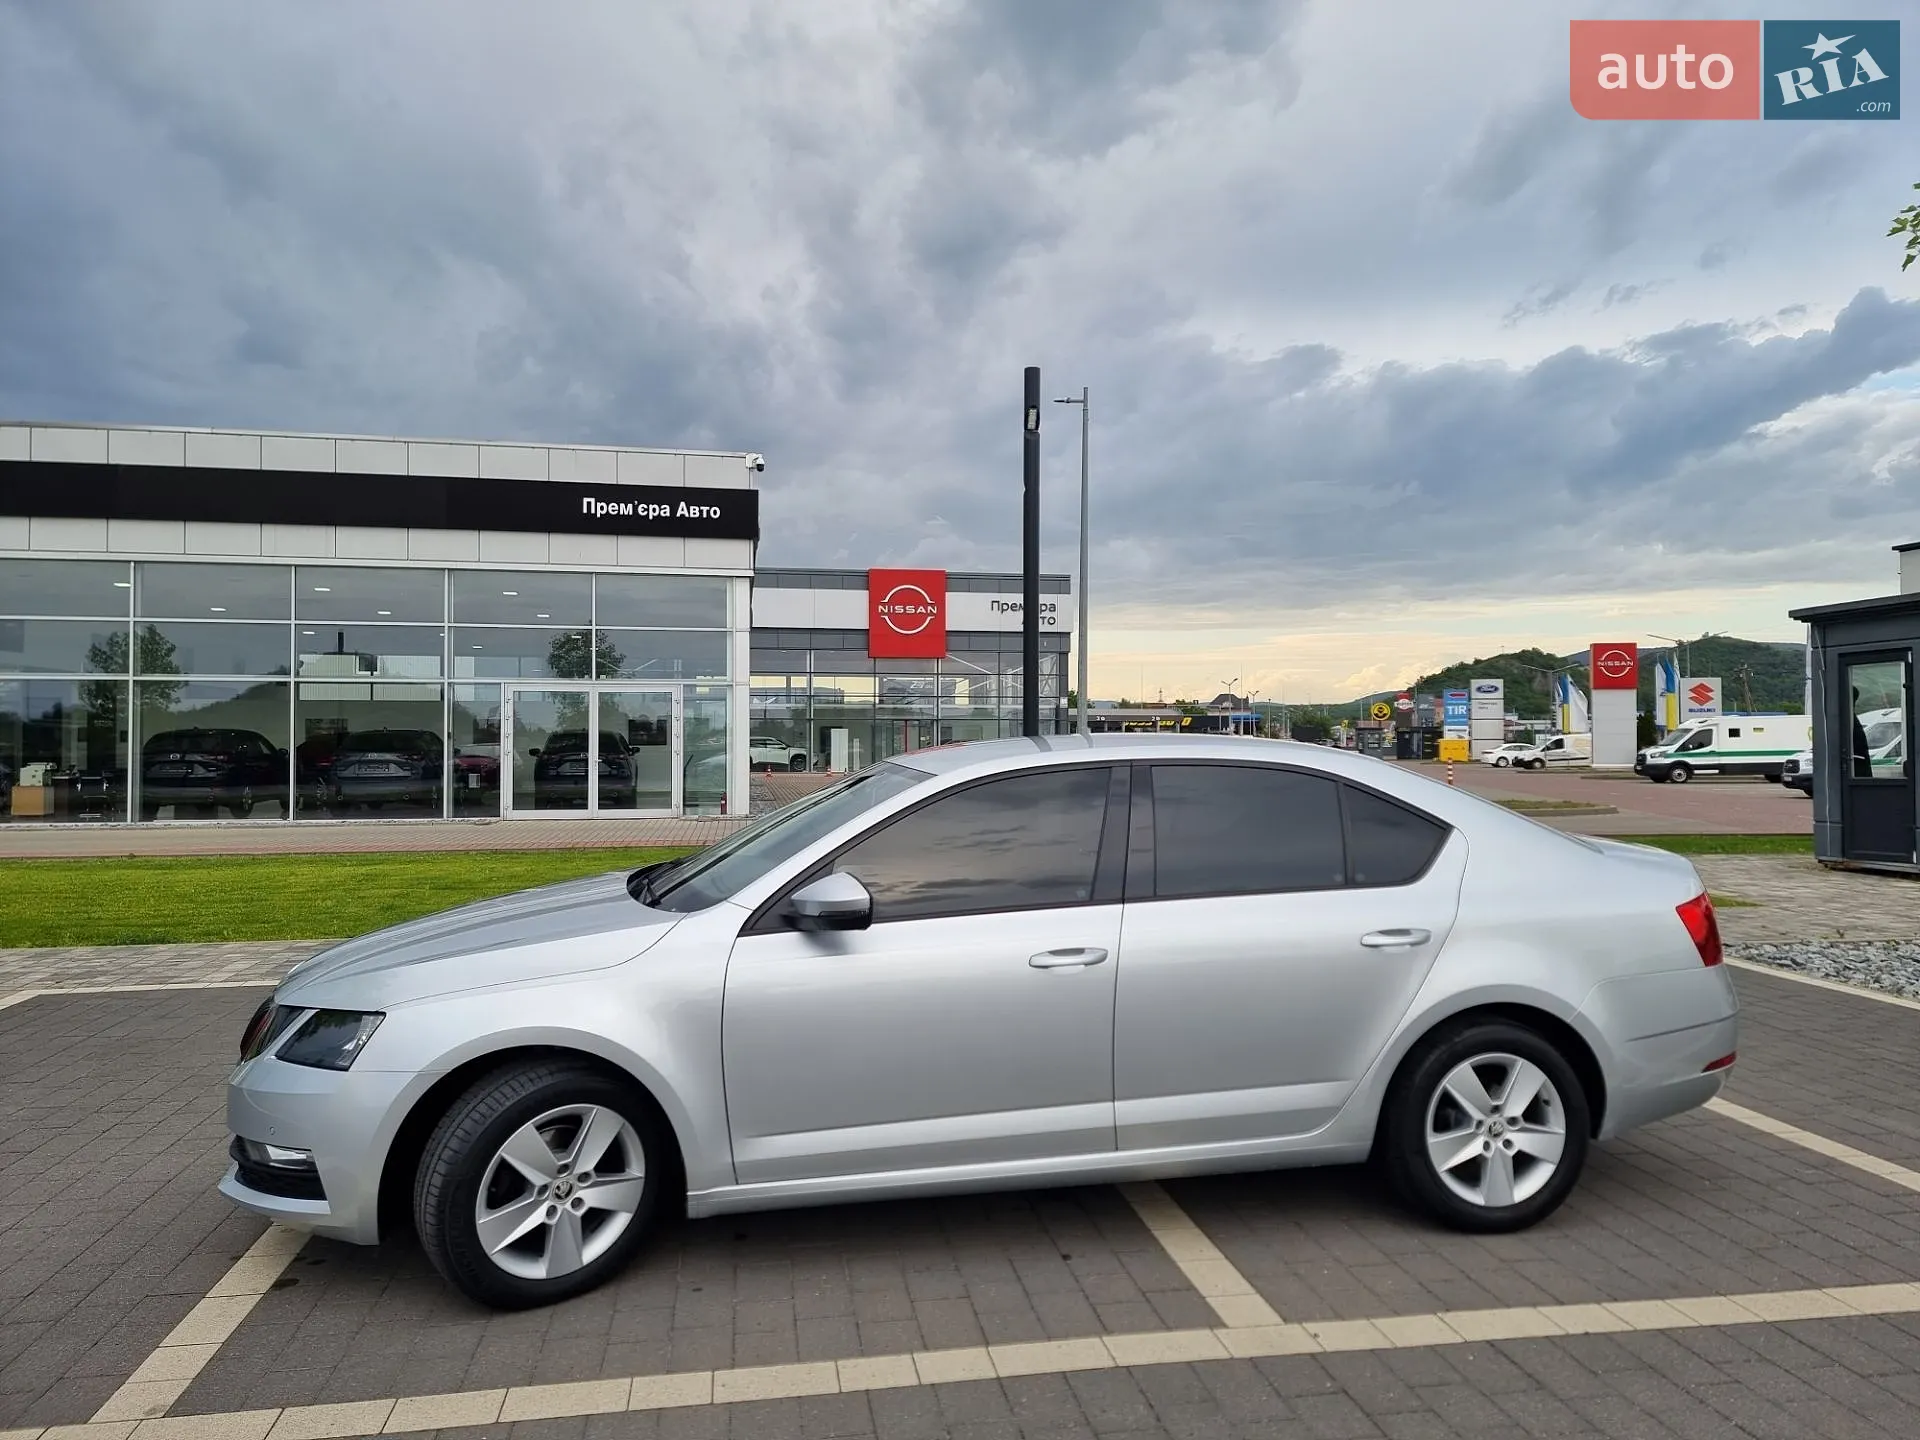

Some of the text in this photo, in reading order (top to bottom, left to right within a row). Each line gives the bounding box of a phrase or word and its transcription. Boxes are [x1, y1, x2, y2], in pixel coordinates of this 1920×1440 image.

[582, 497, 721, 520] Прем'єра Авто
[878, 605, 937, 614] NISSAN
[1447, 705, 1467, 715] TIR
